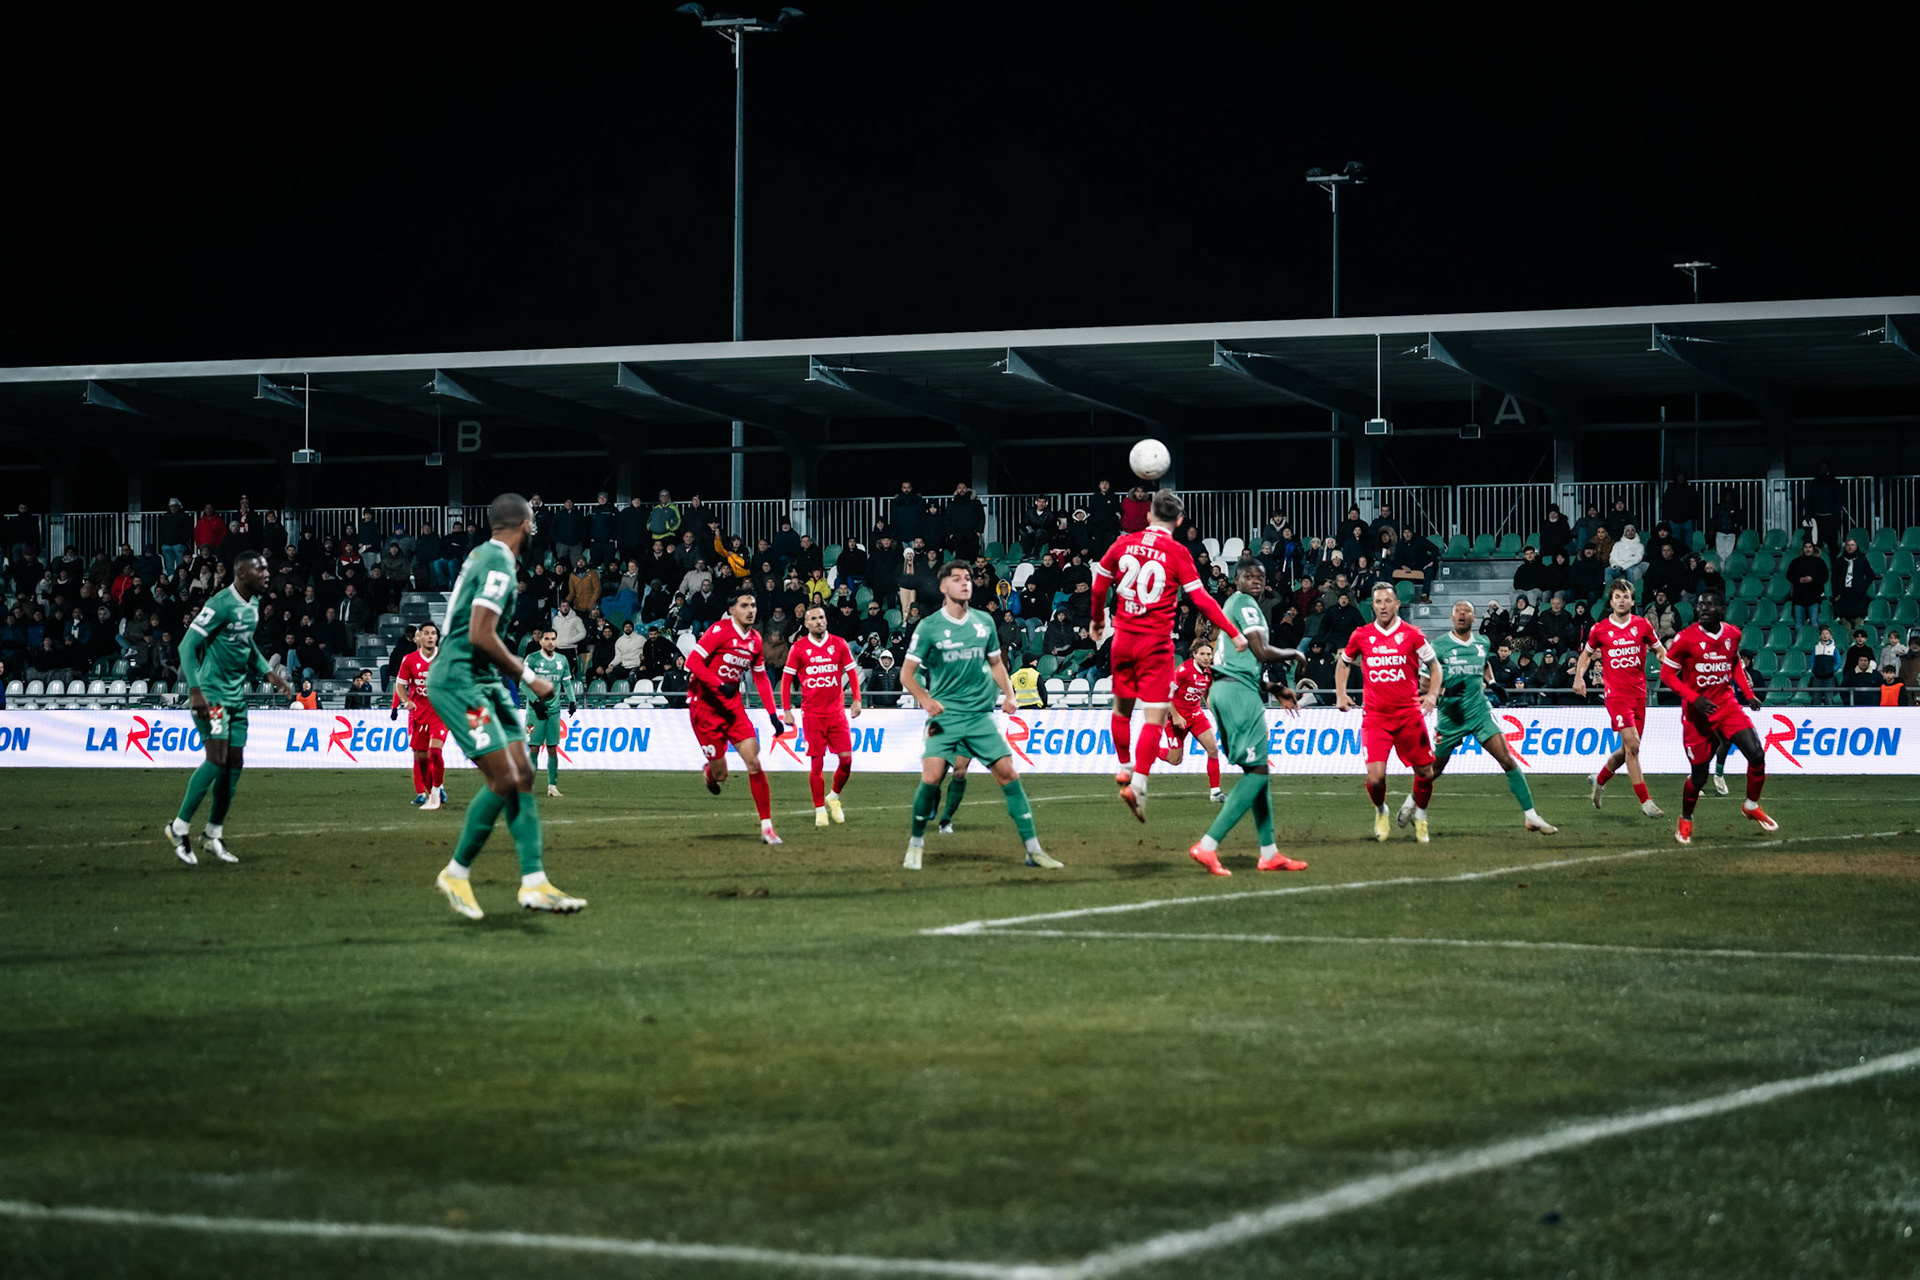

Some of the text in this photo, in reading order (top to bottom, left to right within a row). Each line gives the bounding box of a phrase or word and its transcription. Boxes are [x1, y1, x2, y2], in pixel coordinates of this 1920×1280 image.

[1494, 394, 1526, 424] A
[457, 420, 482, 452] B
[1116, 554, 1167, 604] 20
[1369, 668, 1407, 683] CCSA
[1610, 656, 1642, 669] CCSA
[807, 676, 838, 688] CCSA
[86, 715, 204, 762] LA RÉGIO
[286, 715, 409, 763] LA RÉGIO
[1268, 720, 1361, 758] ÉGION
[1616, 714, 1625, 728] 2
[1006, 715, 1116, 767] RÉGION
[1502, 714, 1622, 768] RÉGION
[1764, 713, 1902, 768] RÉGION
